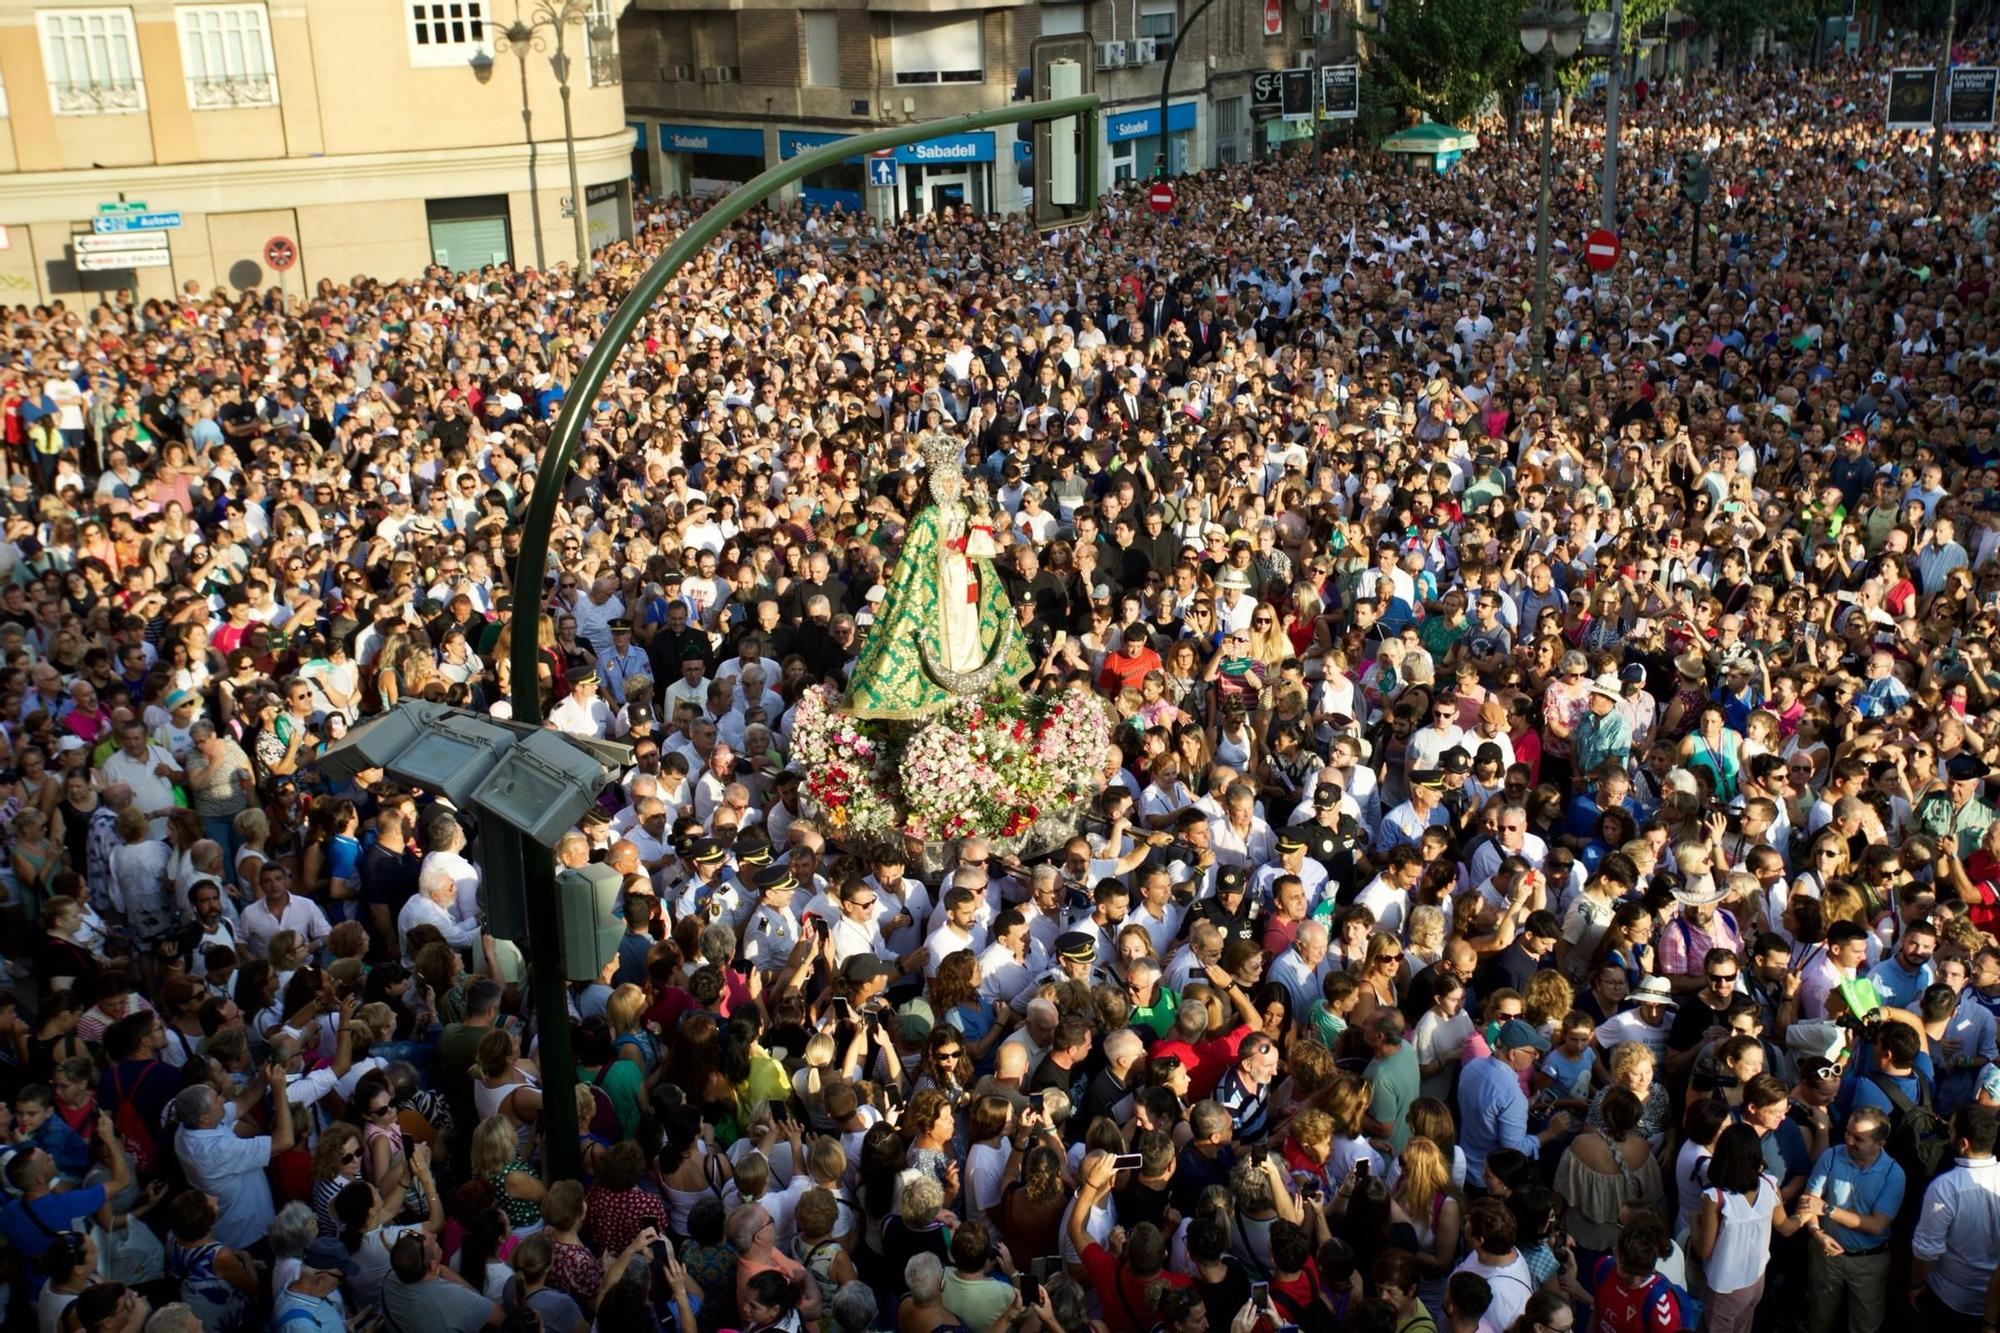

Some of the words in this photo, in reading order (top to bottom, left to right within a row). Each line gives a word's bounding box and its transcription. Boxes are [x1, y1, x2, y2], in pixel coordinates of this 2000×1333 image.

[1325, 70, 1355, 78] Leonardo
[1954, 72, 1994, 81] Leonardo
[1966, 80, 1986, 88] Vinci
[1119, 119, 1148, 136] Sabadell
[675, 135, 708, 149] Sabadell
[916, 143, 976, 159] Sabadell
